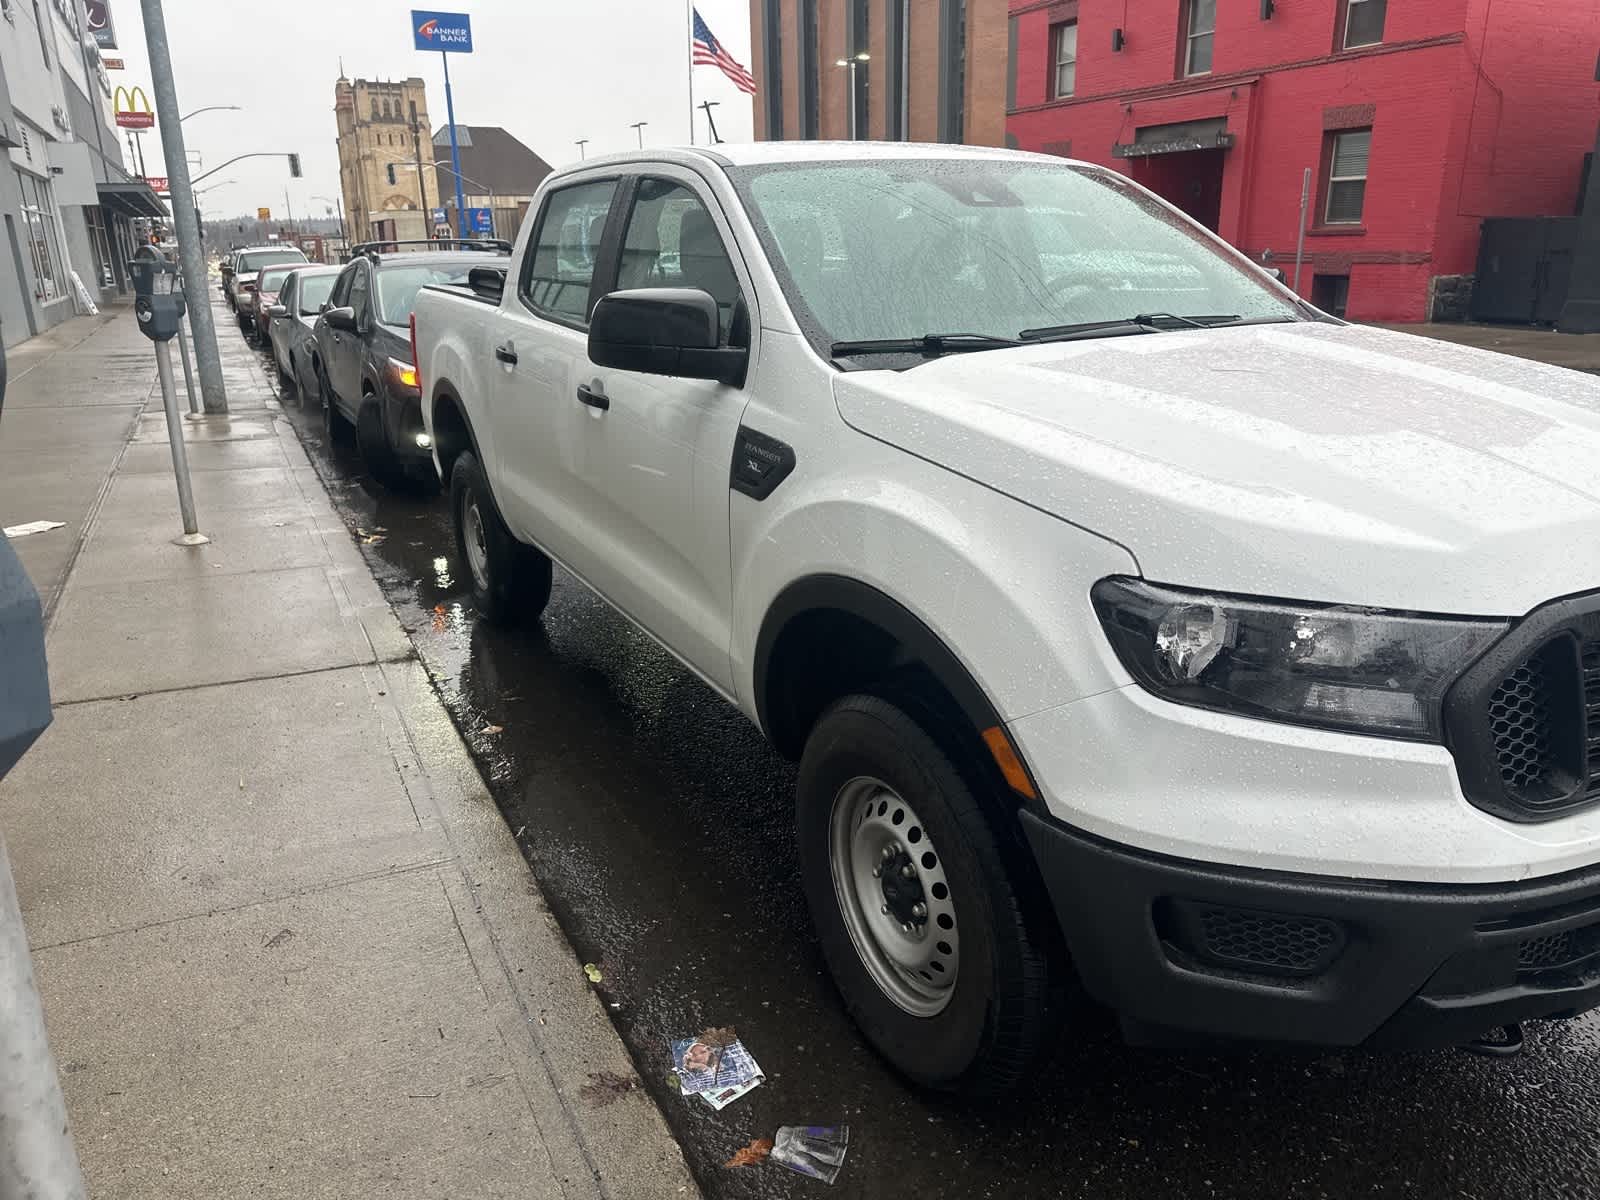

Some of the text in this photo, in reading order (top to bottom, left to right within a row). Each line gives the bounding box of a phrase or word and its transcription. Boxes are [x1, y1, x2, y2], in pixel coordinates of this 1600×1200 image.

[426, 27, 467, 35] BANNER
[440, 35, 467, 43] BANK
[747, 460, 761, 472] XL
